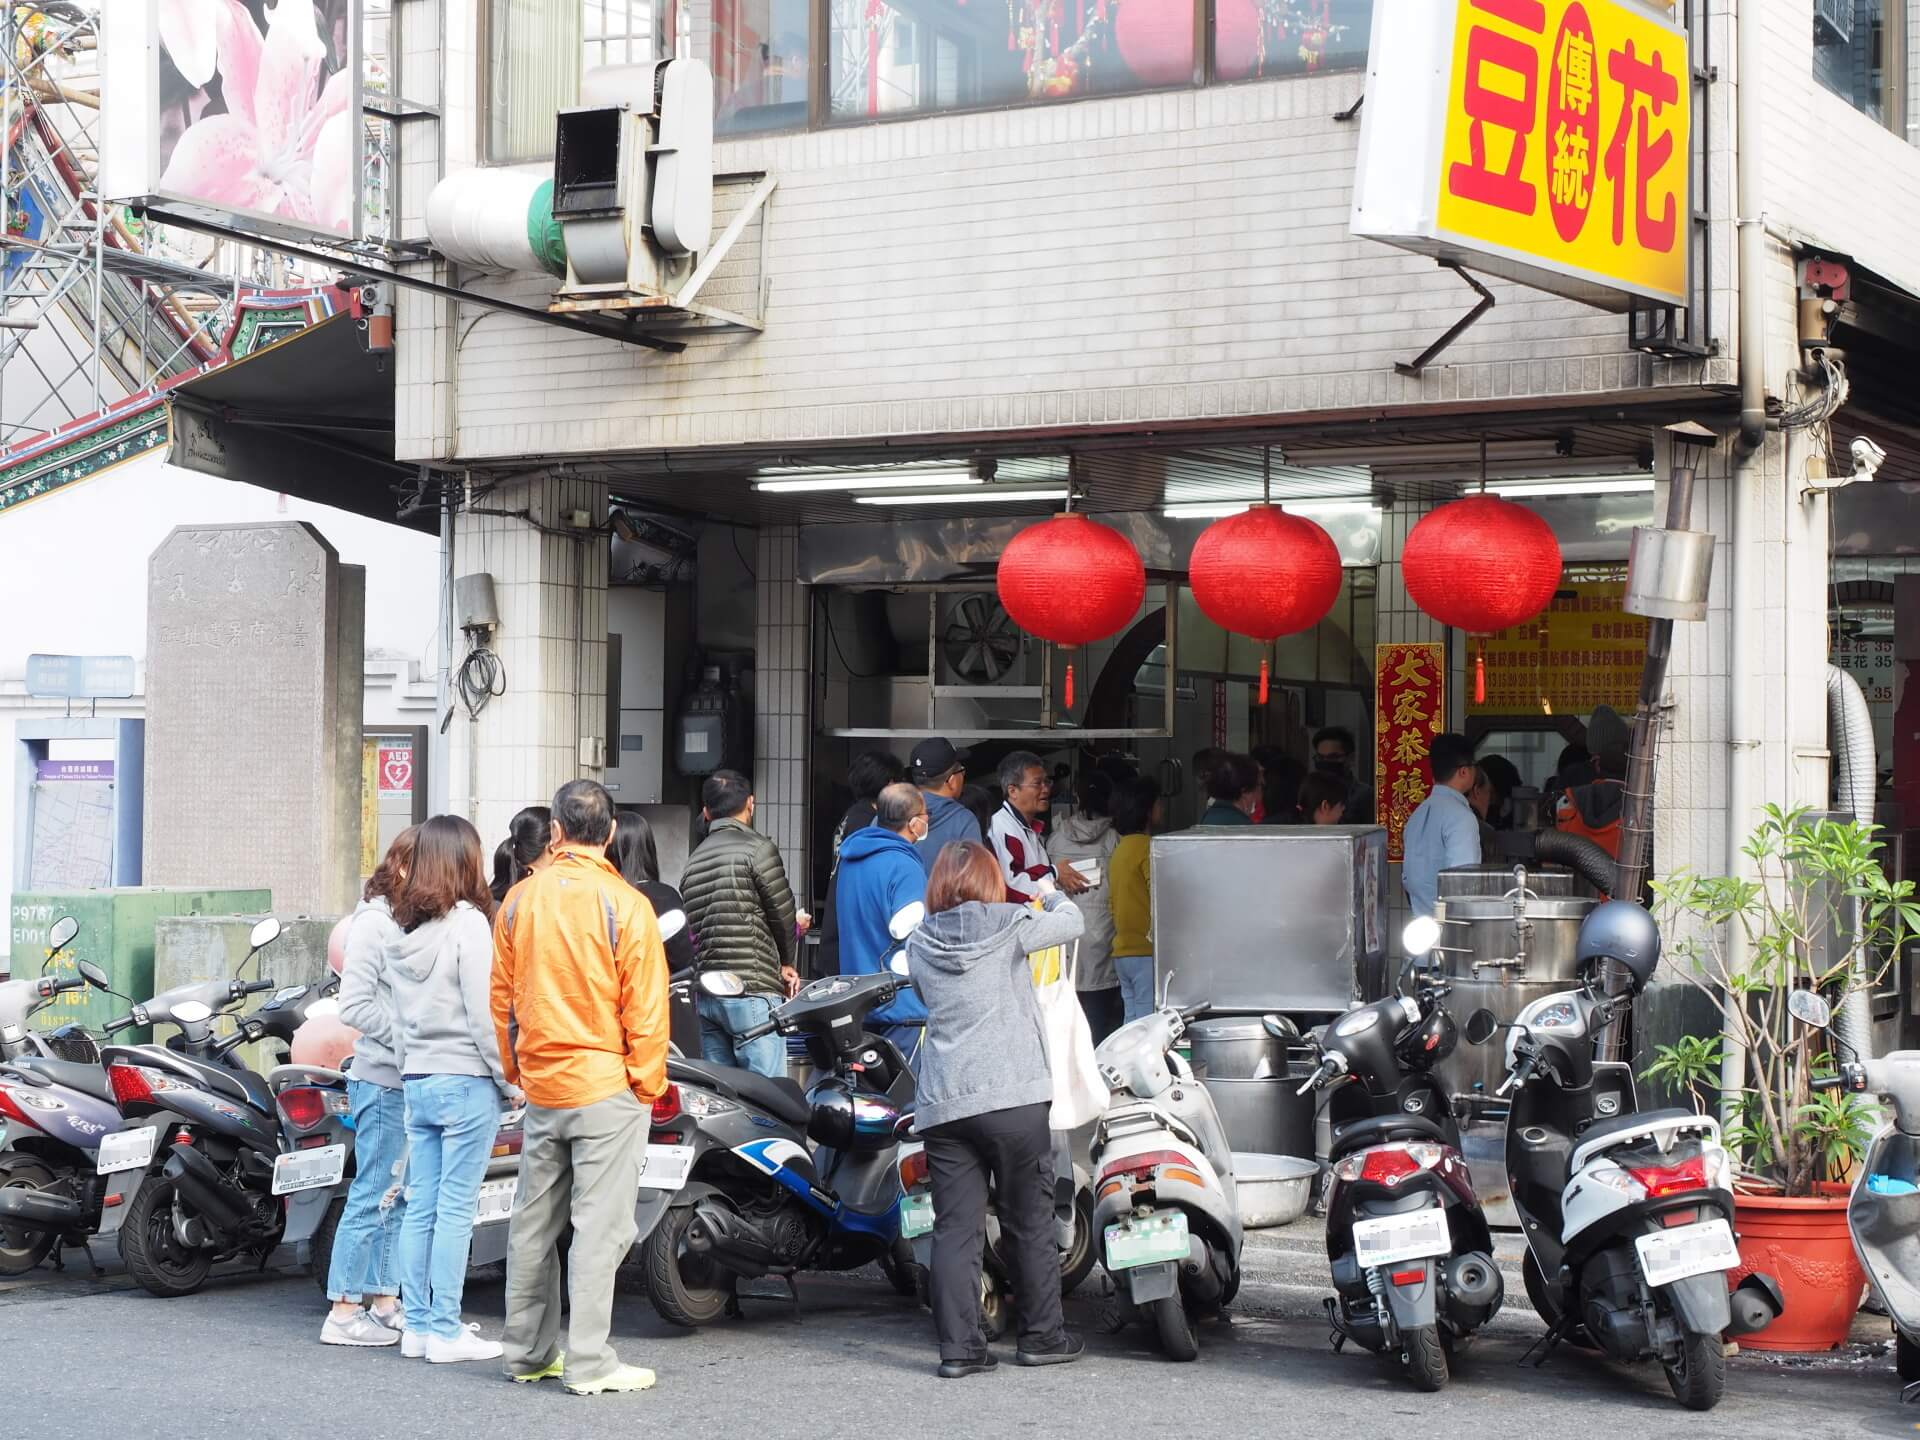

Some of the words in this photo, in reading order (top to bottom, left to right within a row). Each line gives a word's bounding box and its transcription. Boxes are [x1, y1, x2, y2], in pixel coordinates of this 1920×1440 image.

[1551, 27, 1593, 210] 傳統
[1874, 639, 1892, 653] 35
[1874, 655, 1892, 668] 35
[1874, 686, 1892, 699] 35
[388, 751, 410, 761] AED
